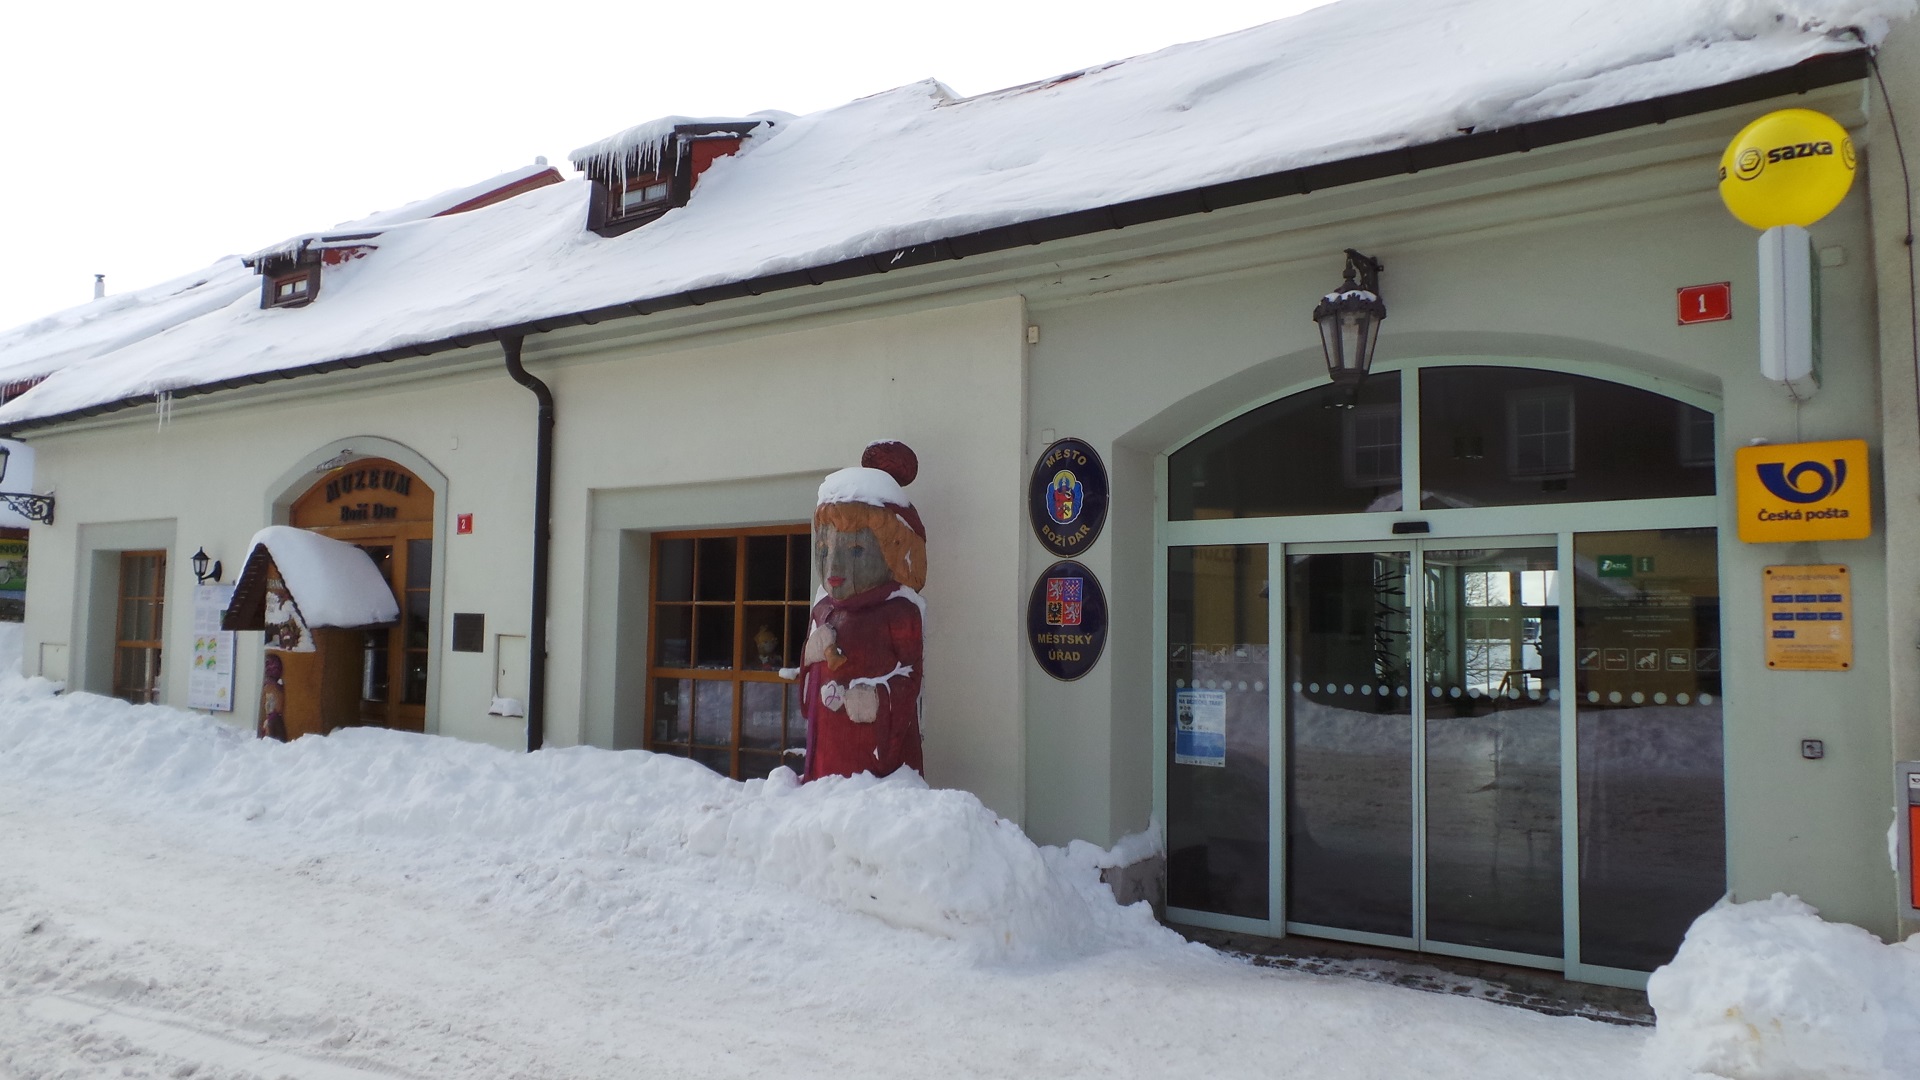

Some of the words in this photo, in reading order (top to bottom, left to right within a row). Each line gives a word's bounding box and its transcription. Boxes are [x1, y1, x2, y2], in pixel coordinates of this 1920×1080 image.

[1697, 293, 1707, 313] 1
[1045, 448, 1087, 468] MĚSTO
[327, 470, 411, 502] MUZEUM
[1757, 508, 1803, 522] Česká
[1805, 506, 1849, 522] pošta
[461, 518, 466, 529] 2
[1042, 524, 1066, 547] BOŽÍ
[1068, 523, 1091, 547] DAR
[1037, 632, 1092, 645] MĚSTSKÝ
[1048, 648, 1081, 661] ÚŘAD
